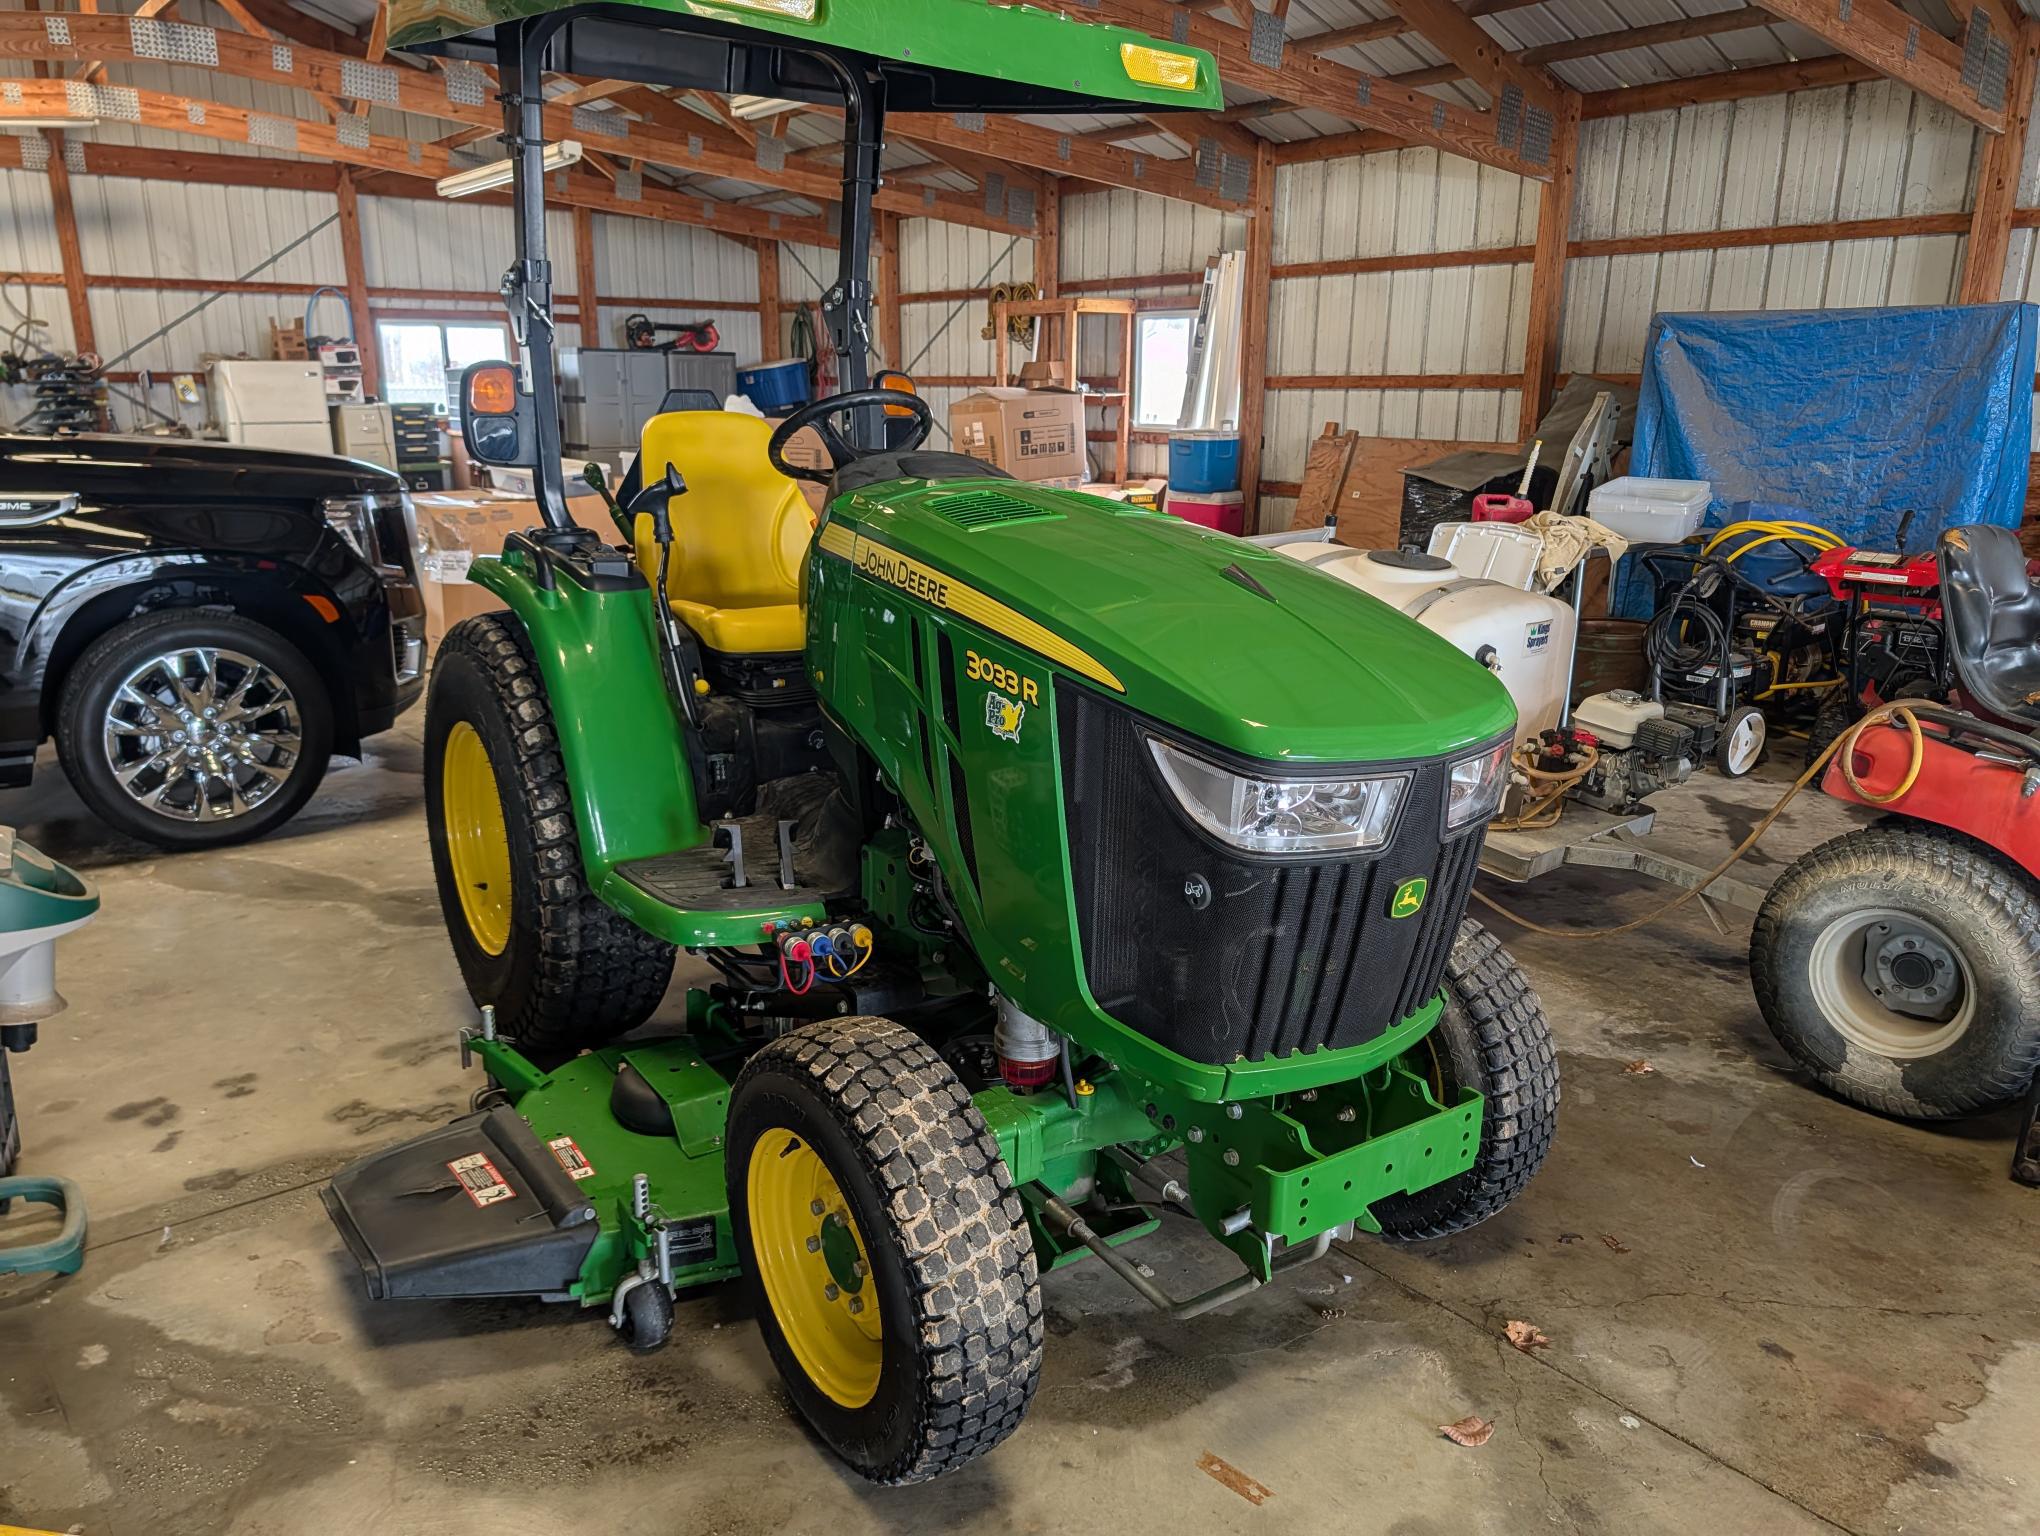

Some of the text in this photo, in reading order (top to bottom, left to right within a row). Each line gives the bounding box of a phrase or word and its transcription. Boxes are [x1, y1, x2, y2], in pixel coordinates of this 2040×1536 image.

[860, 546, 949, 607] JOHN DEERE
[1750, 619, 1776, 628] CHAMPIO
